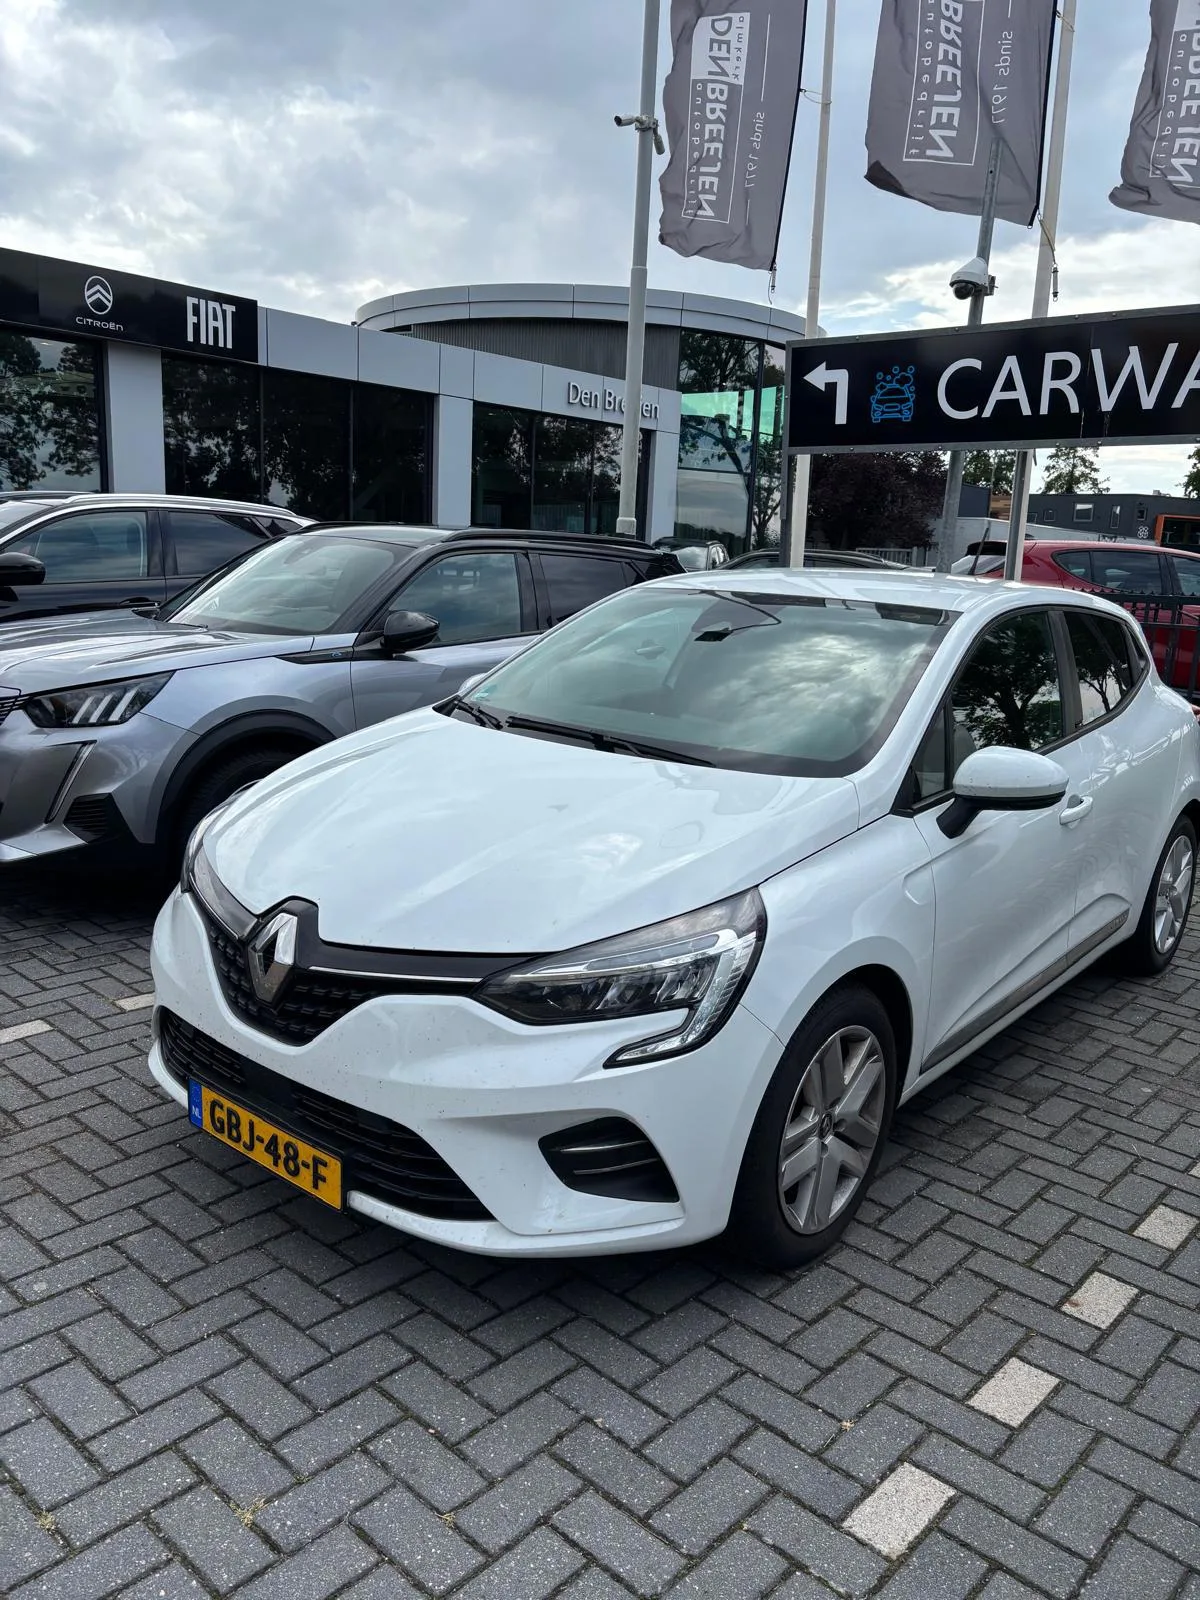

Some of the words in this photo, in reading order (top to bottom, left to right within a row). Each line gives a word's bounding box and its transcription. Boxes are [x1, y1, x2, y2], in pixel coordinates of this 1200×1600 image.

[75, 316, 124, 332] CITROËN
[186, 296, 236, 349] FIAT
[568, 381, 600, 409] Den
[604, 389, 660, 419] Bren
[191, 1106, 202, 1119] NL
[210, 1098, 328, 1190] GBJ-48-F
